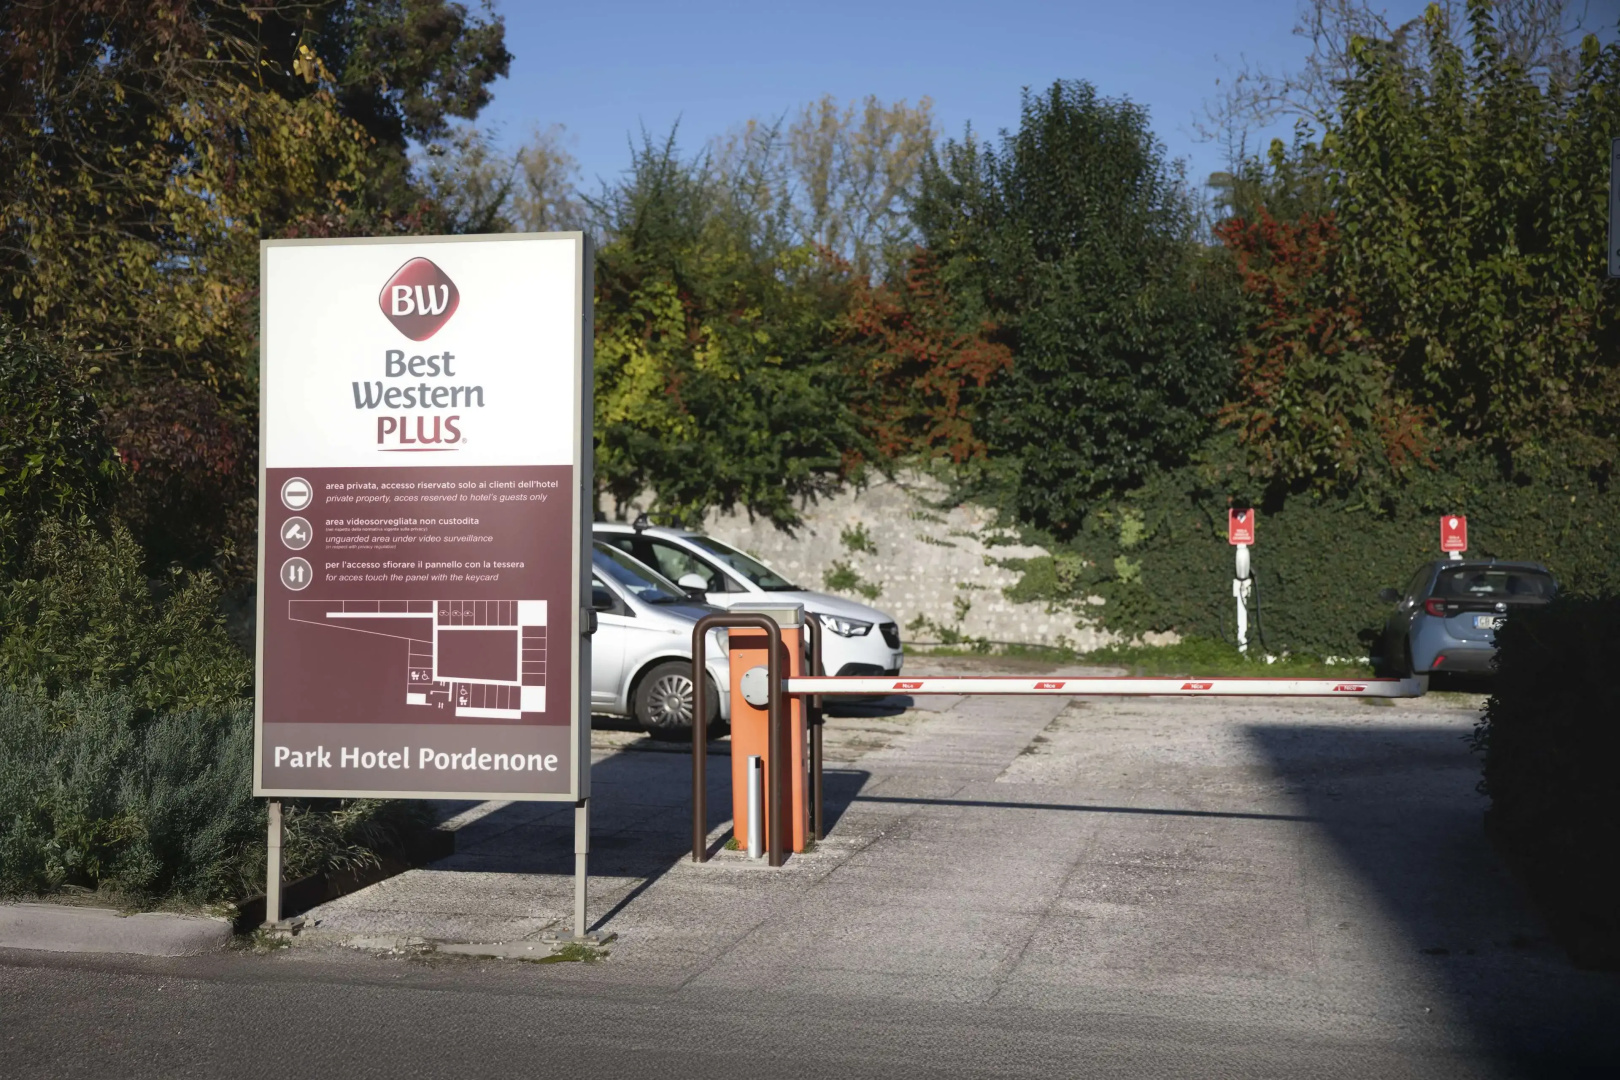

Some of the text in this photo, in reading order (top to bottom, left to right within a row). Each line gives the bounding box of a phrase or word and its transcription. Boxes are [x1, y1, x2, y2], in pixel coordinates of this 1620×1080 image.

[391, 284, 449, 316] BW
[385, 349, 456, 378] Best
[352, 380, 485, 410] Western
[346, 482, 379, 491] privata,
[417, 481, 456, 490] riservato
[458, 480, 476, 489] solo
[478, 480, 486, 489] ai
[488, 480, 516, 488] clienti
[518, 480, 559, 488] dell'hotel
[325, 494, 354, 504] private
[355, 494, 391, 504] property,
[420, 494, 458, 502] reserved
[460, 494, 468, 502] to
[470, 493, 498, 502] hotel's
[499, 494, 528, 502] guests
[529, 493, 548, 502] only
[346, 518, 418, 526] videosorvegliata
[438, 517, 480, 525] custodita
[325, 535, 370, 544] unguarded
[418, 534, 442, 542] video
[443, 534, 494, 542] surveillance
[326, 562, 340, 570] per
[342, 560, 380, 568] l'accesso
[382, 560, 415, 568] sfiorare
[418, 560, 422, 568] il
[425, 560, 462, 570] pannello
[405, 574, 429, 582] panel
[465, 574, 499, 582] keycard
[274, 746, 558, 772] Park Hotel Pordenone
